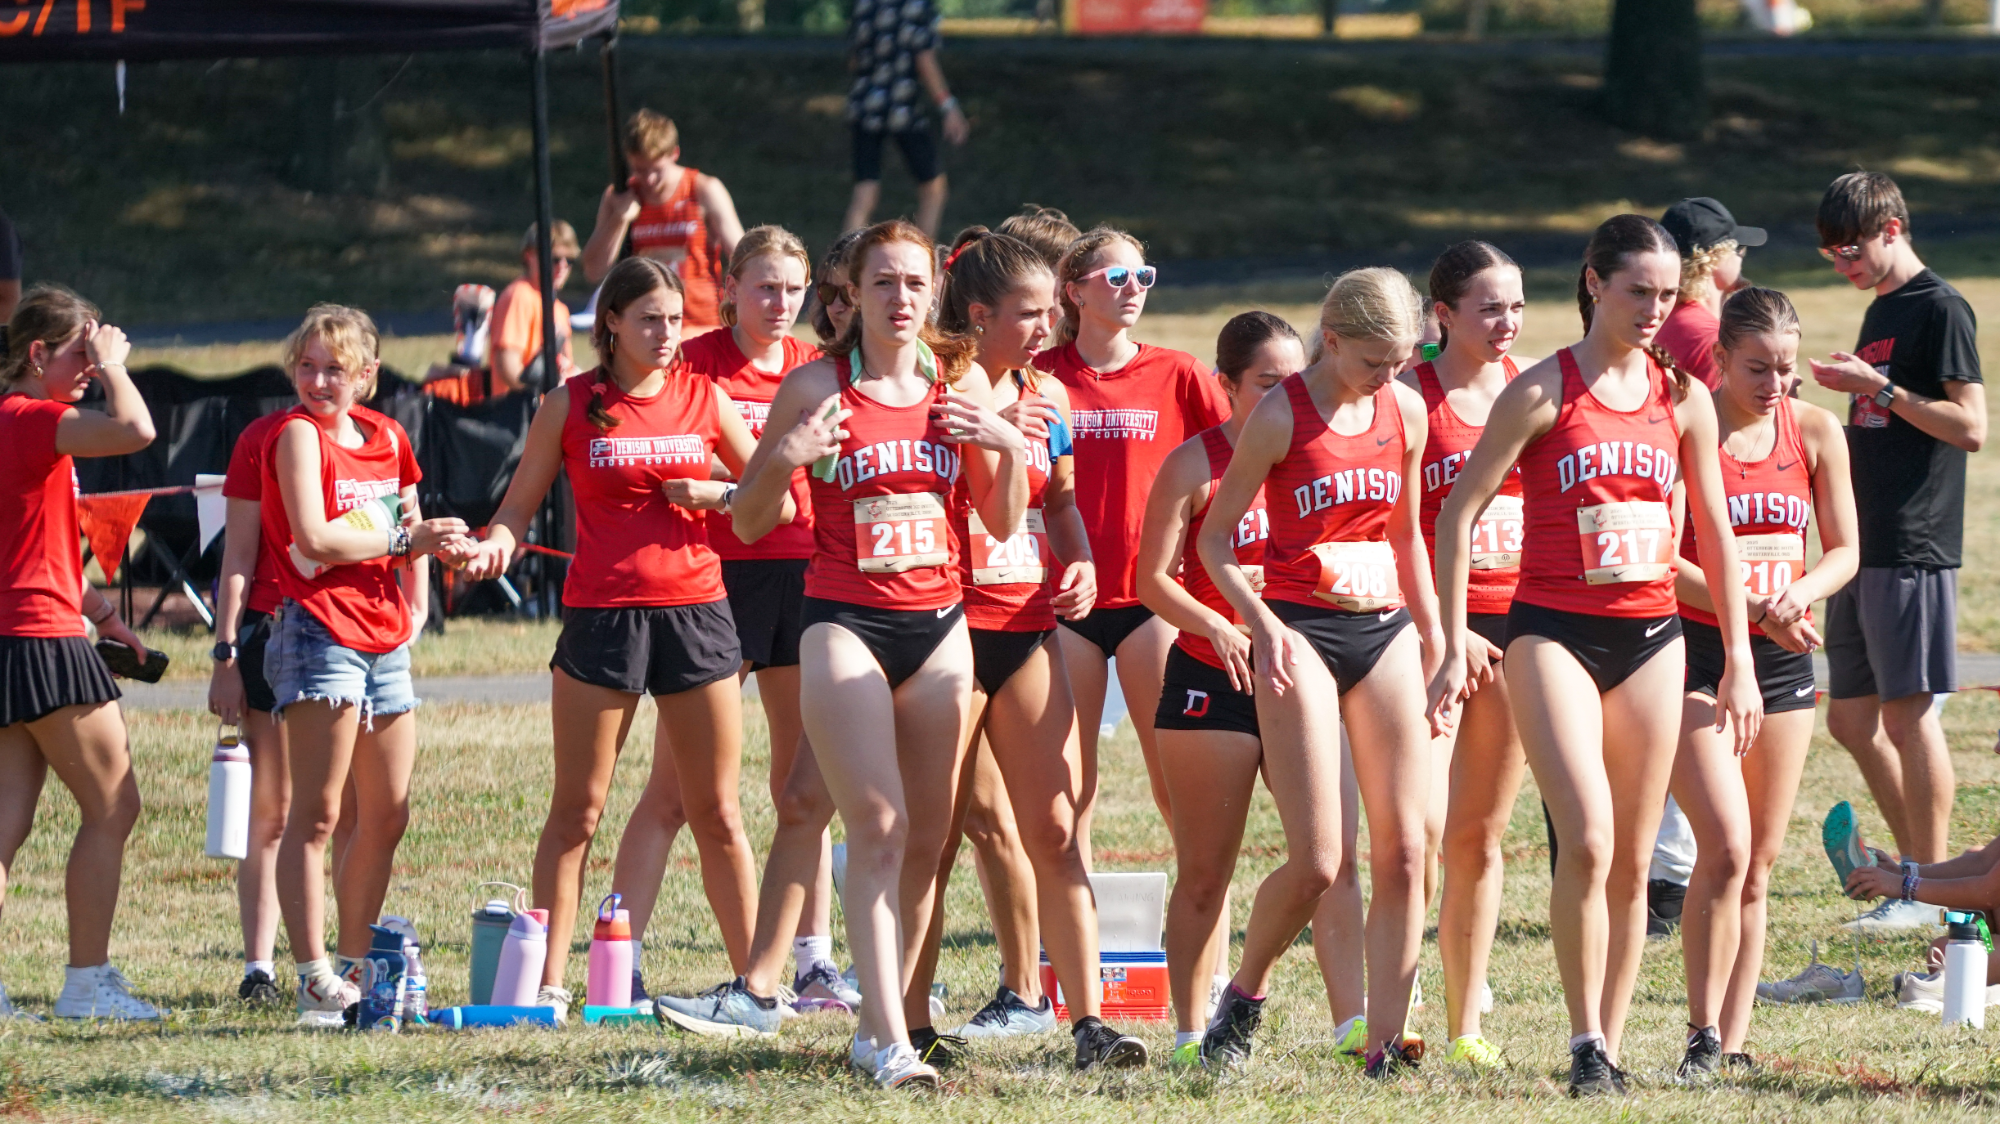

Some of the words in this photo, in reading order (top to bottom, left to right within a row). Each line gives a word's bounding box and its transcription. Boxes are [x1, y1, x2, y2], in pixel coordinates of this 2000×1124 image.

[1071, 413, 1103, 428] DENISON
[1105, 413, 1155, 429] UNIVERSITY
[1095, 430, 1155, 442] COUNTRY
[590, 458, 635, 468] CROSS
[645, 455, 705, 465] COUNTRY
[616, 440, 652, 455] DENISON
[653, 437, 701, 454] UNIVERSITY
[837, 439, 960, 492] DENISON
[1557, 441, 1678, 498] DENISON
[1294, 467, 1402, 519] DENISO
[1728, 491, 1811, 530] NISON
[871, 520, 936, 556] 215
[985, 533, 1040, 567] 209
[1597, 529, 1660, 567] 217
[1330, 561, 1388, 598] 208
[1183, 689, 1210, 717] D
